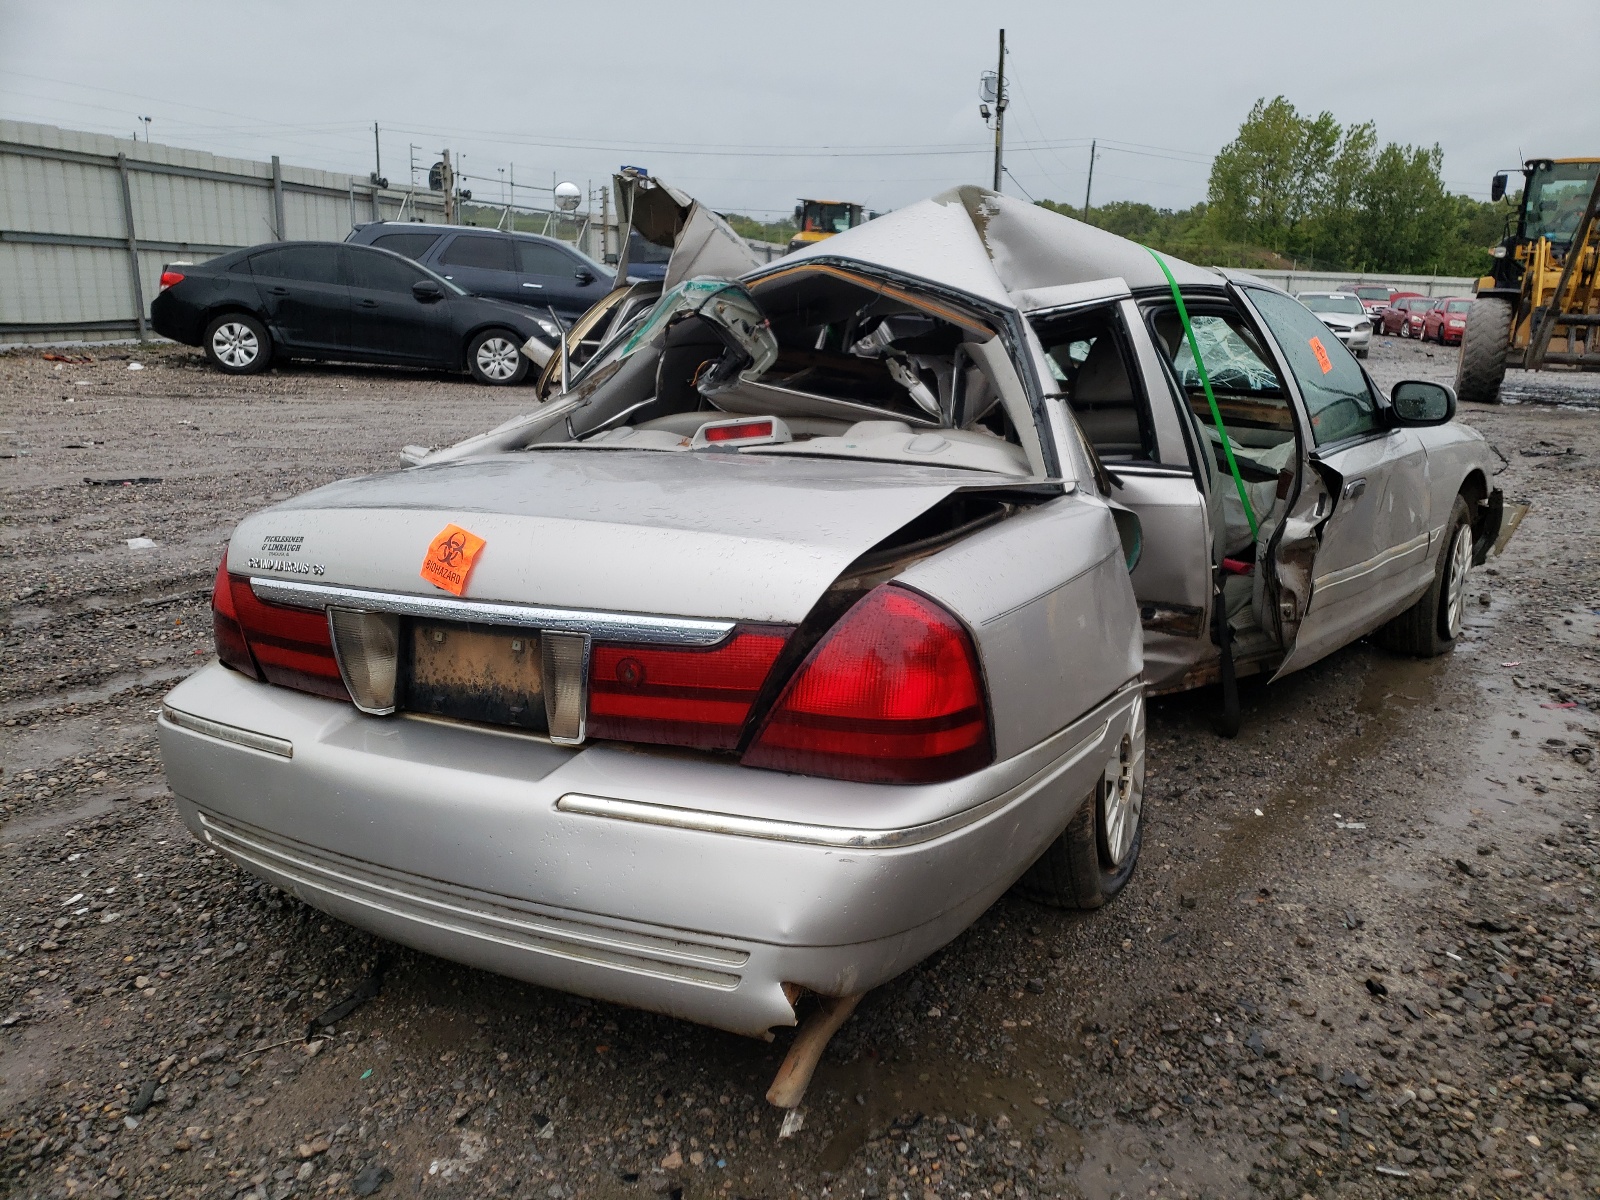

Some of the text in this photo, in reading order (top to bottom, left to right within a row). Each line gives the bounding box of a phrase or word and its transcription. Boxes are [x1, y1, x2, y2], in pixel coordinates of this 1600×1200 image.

[264, 535, 304, 543] PICKLESIMER
[267, 544, 302, 552] LIMBAUGH
[248, 557, 273, 570] GRAND
[273, 560, 310, 574] MARQUIS
[426, 560, 460, 584] BIOHAZARD
